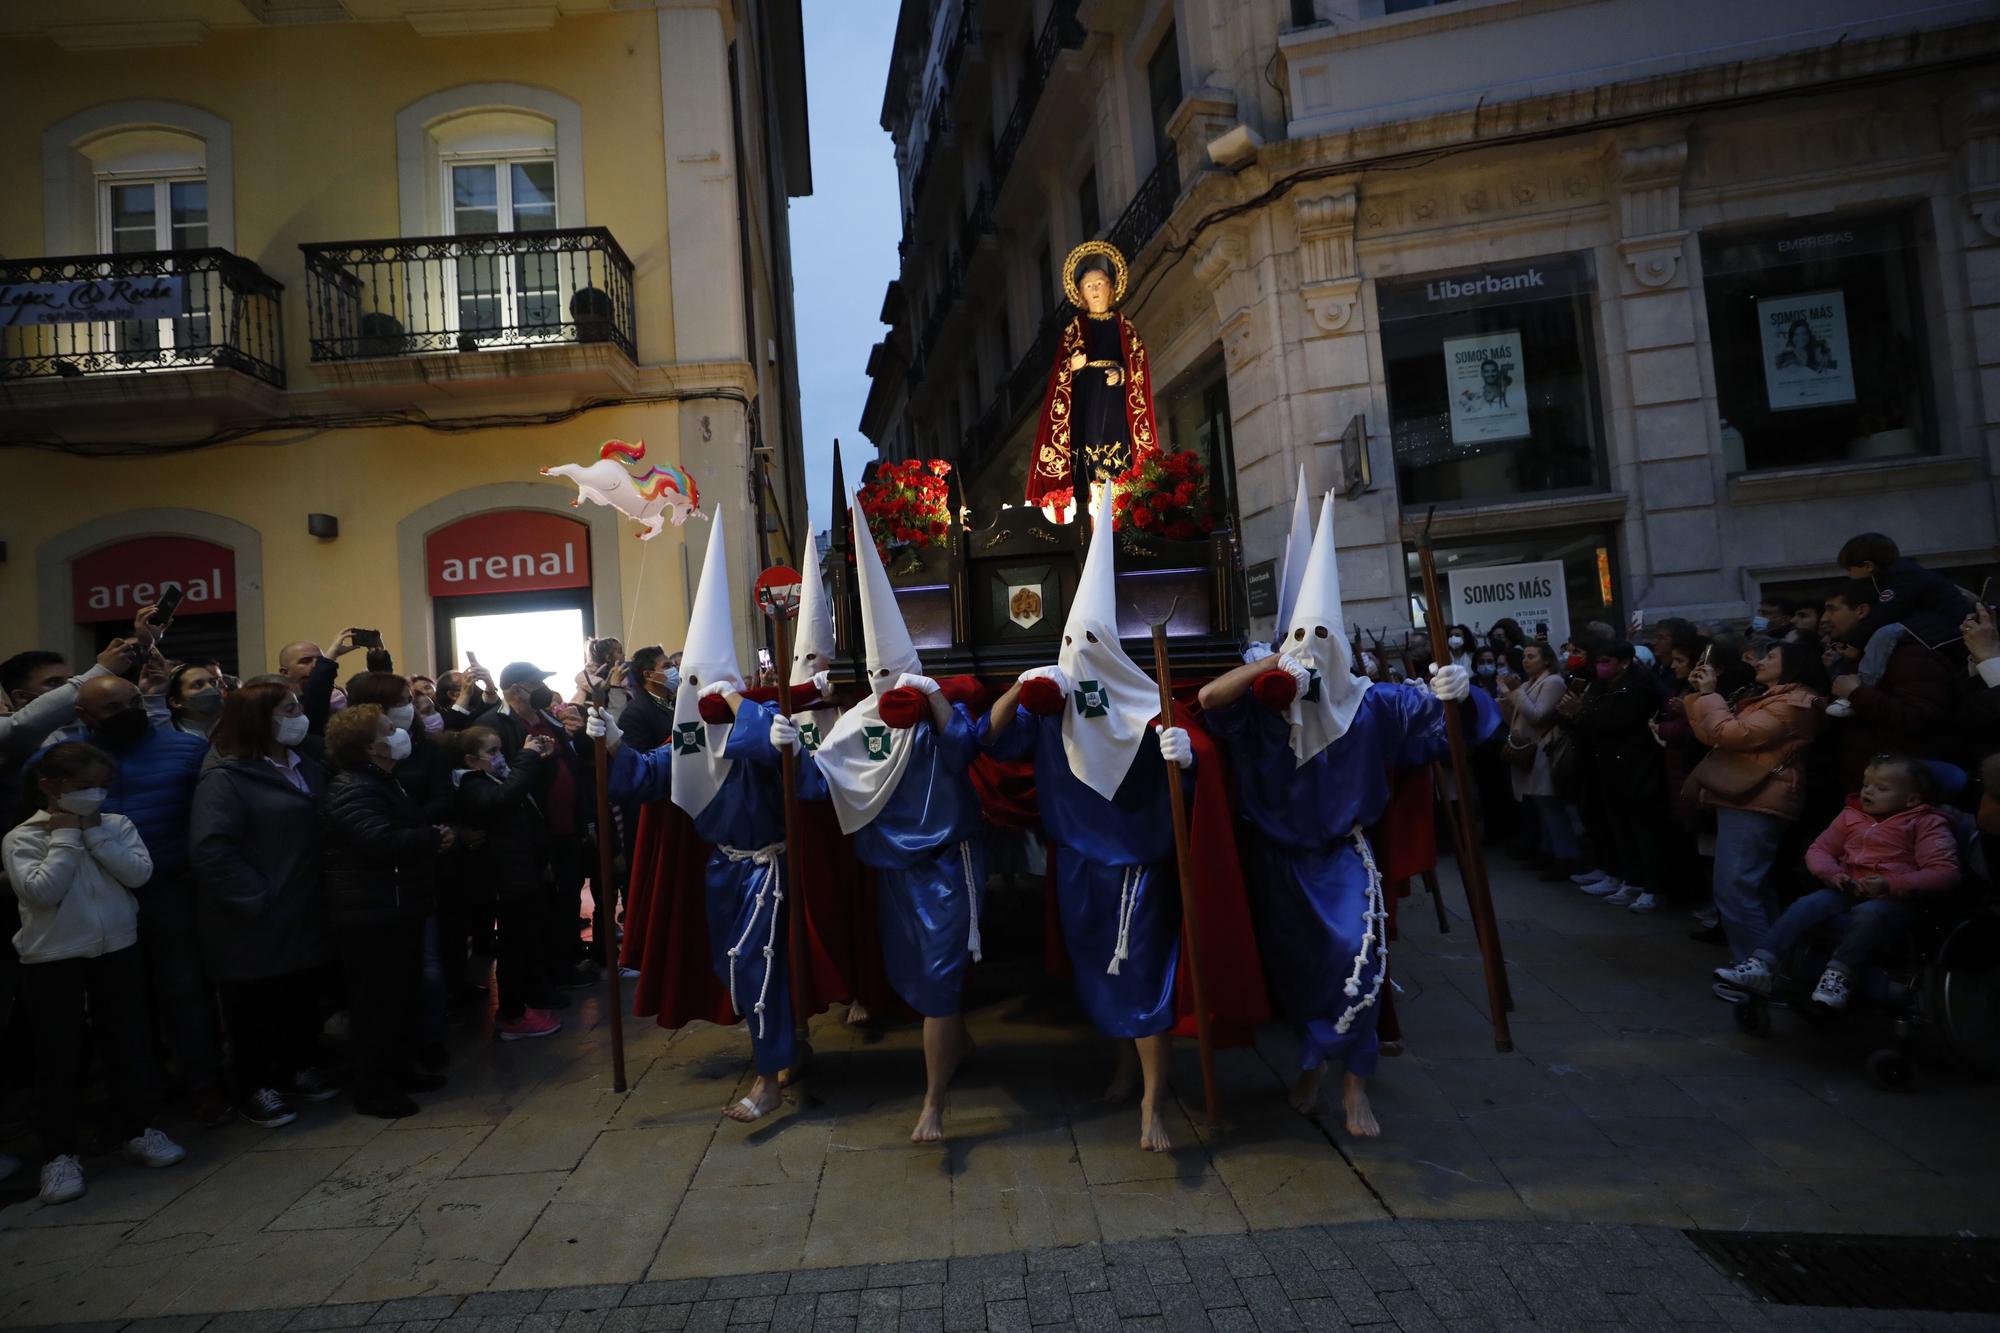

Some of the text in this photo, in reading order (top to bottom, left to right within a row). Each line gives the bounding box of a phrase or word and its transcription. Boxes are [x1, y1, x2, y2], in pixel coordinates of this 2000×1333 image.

[1778, 231, 1854, 252] EMPRESAS
[1426, 269, 1544, 301] Liberbank
[1771, 309, 1808, 325] SOMOS
[1455, 344, 1512, 364] SOMOS MÁS
[442, 542, 574, 582] arenal
[1464, 576, 1552, 605] SOMOS MÁS
